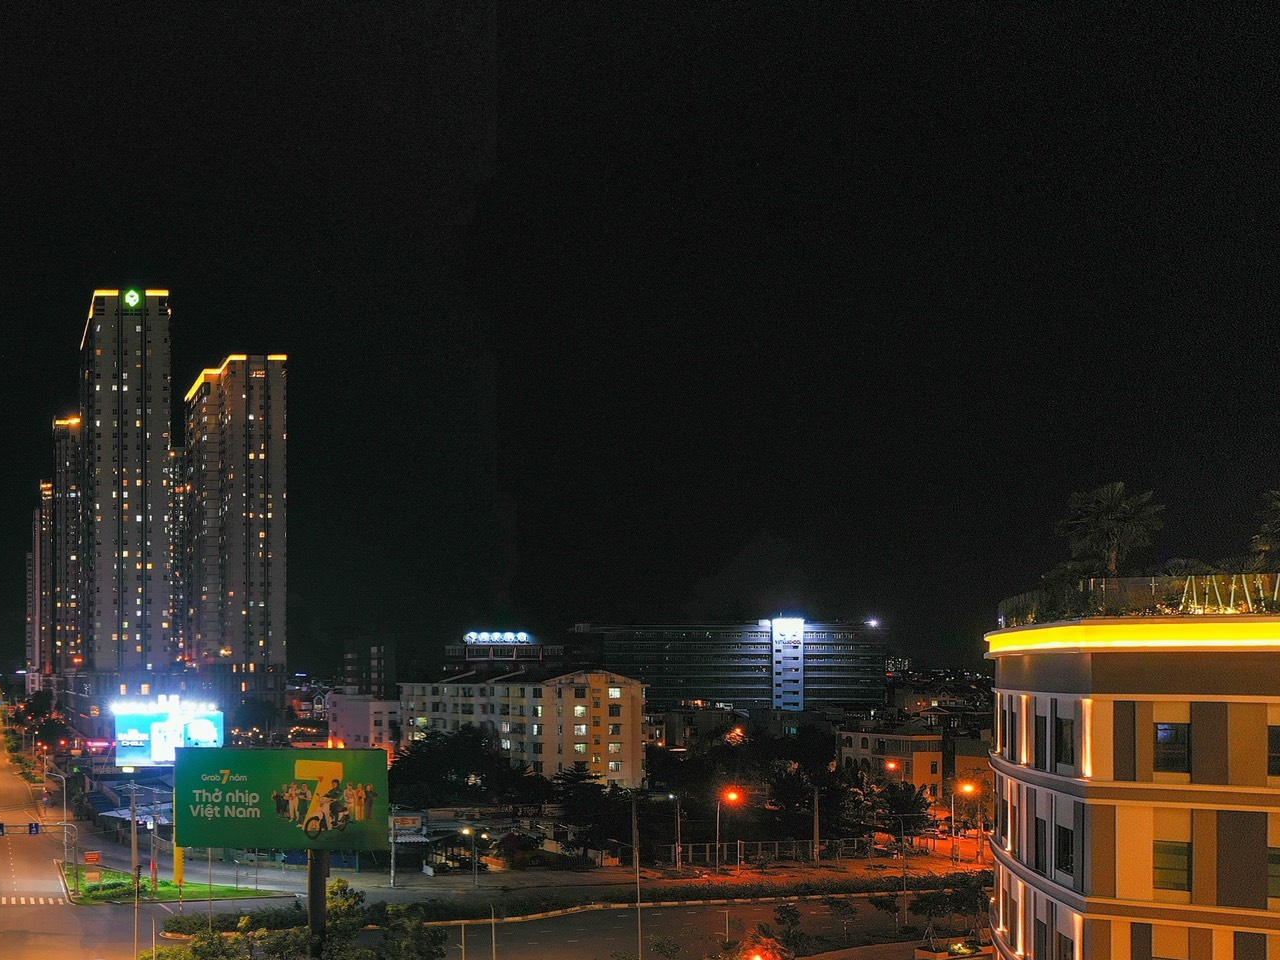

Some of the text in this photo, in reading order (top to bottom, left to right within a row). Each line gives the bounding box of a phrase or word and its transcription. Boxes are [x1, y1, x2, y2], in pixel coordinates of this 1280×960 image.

[201, 769, 248, 785] Grab 7 năm
[192, 787, 260, 806] Thở nhịp
[189, 803, 261, 821] Việt Nam
